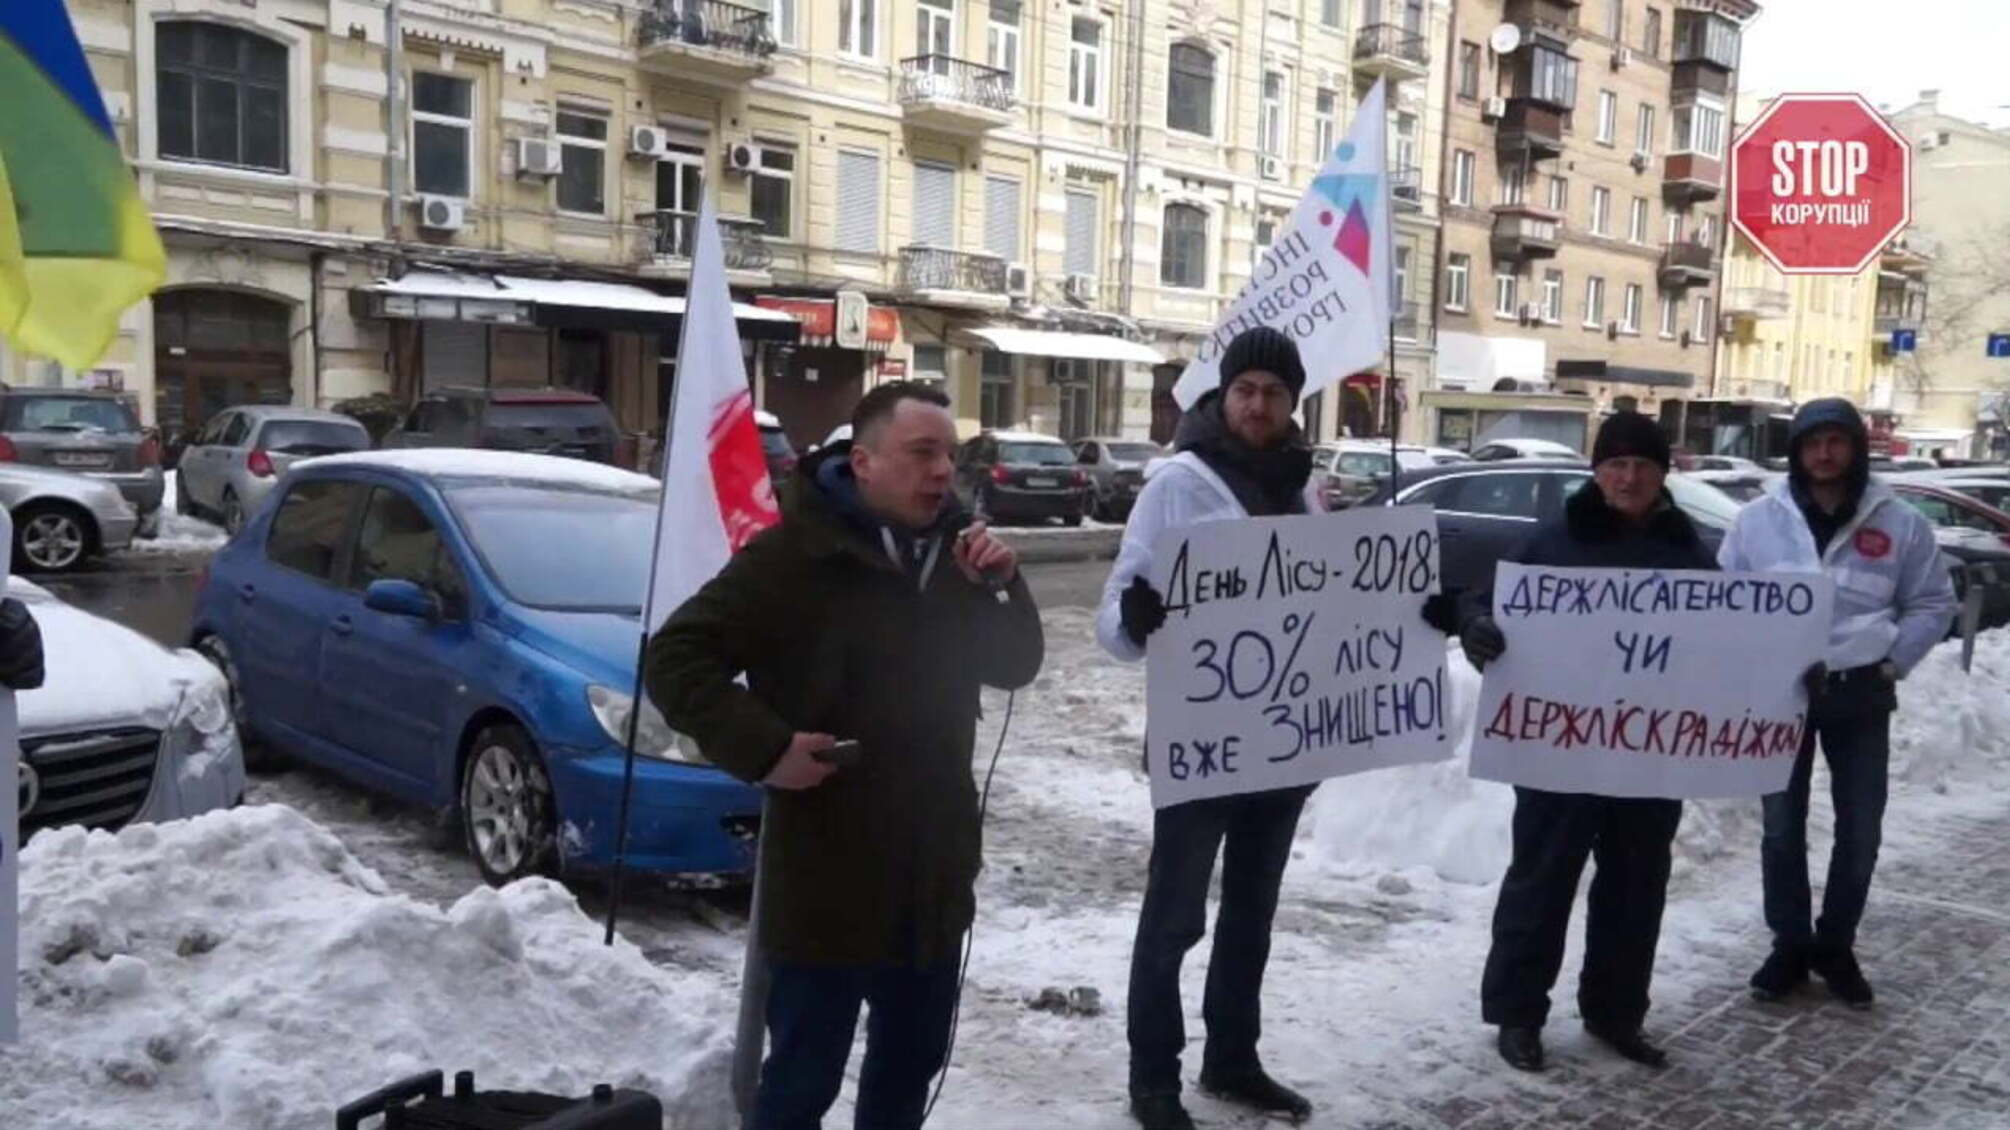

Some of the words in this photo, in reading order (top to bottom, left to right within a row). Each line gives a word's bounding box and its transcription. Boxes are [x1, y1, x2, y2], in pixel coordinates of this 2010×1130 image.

[1502, 571, 1814, 618] ДЕРЖЛІСАГЕНСТВО
[1185, 610, 1316, 703] 30%
[1614, 630, 1673, 674] ЧИ
